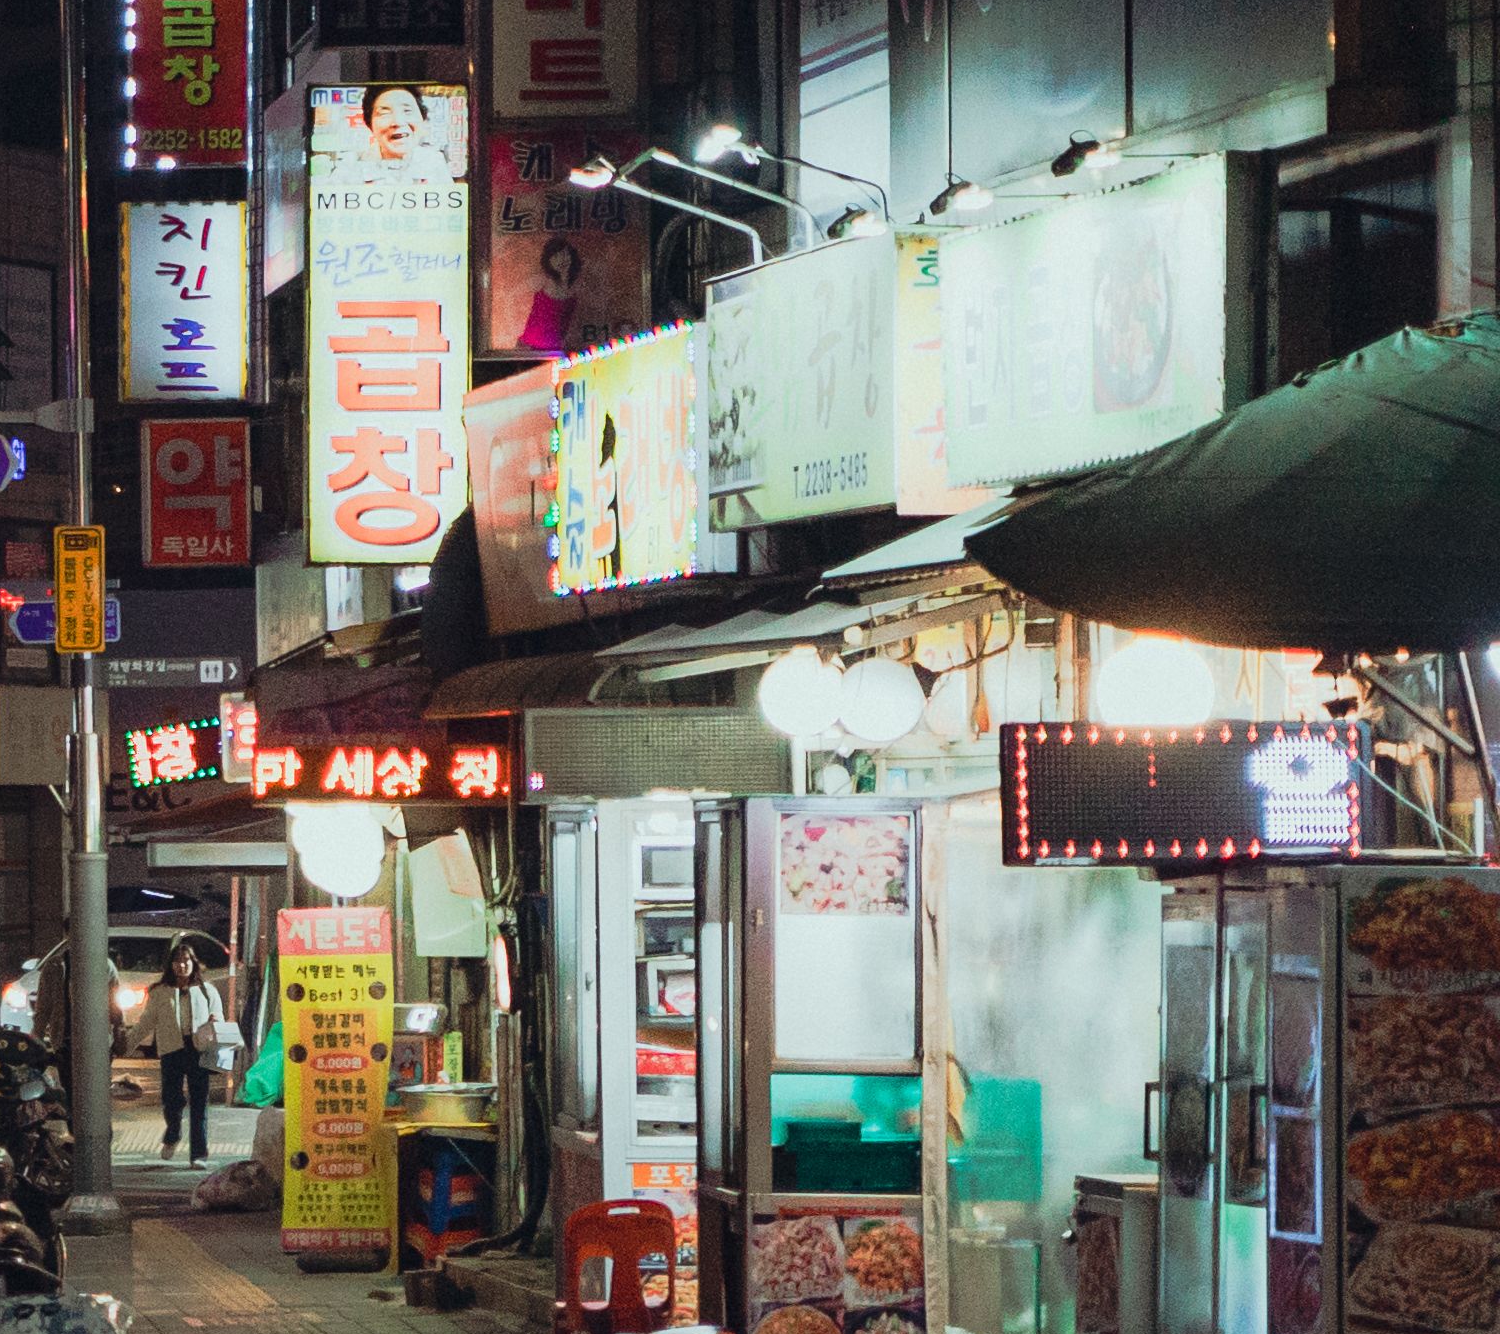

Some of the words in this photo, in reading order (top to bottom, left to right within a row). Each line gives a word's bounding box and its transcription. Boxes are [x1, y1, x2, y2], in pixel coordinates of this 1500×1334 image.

[140, 126, 244, 152] 2252-1582
[316, 191, 464, 211] MBC/SBS
[498, 194, 628, 234] 노래방
[154, 213, 213, 301] 치킨
[315, 241, 389, 287] 원조
[154, 317, 220, 393] 호프
[327, 300, 455, 547] 곱창
[155, 433, 242, 532] 약
[791, 451, 869, 501] T.2238-5485
[161, 534, 234, 558] 독일사
[309, 988, 343, 1003] Best
